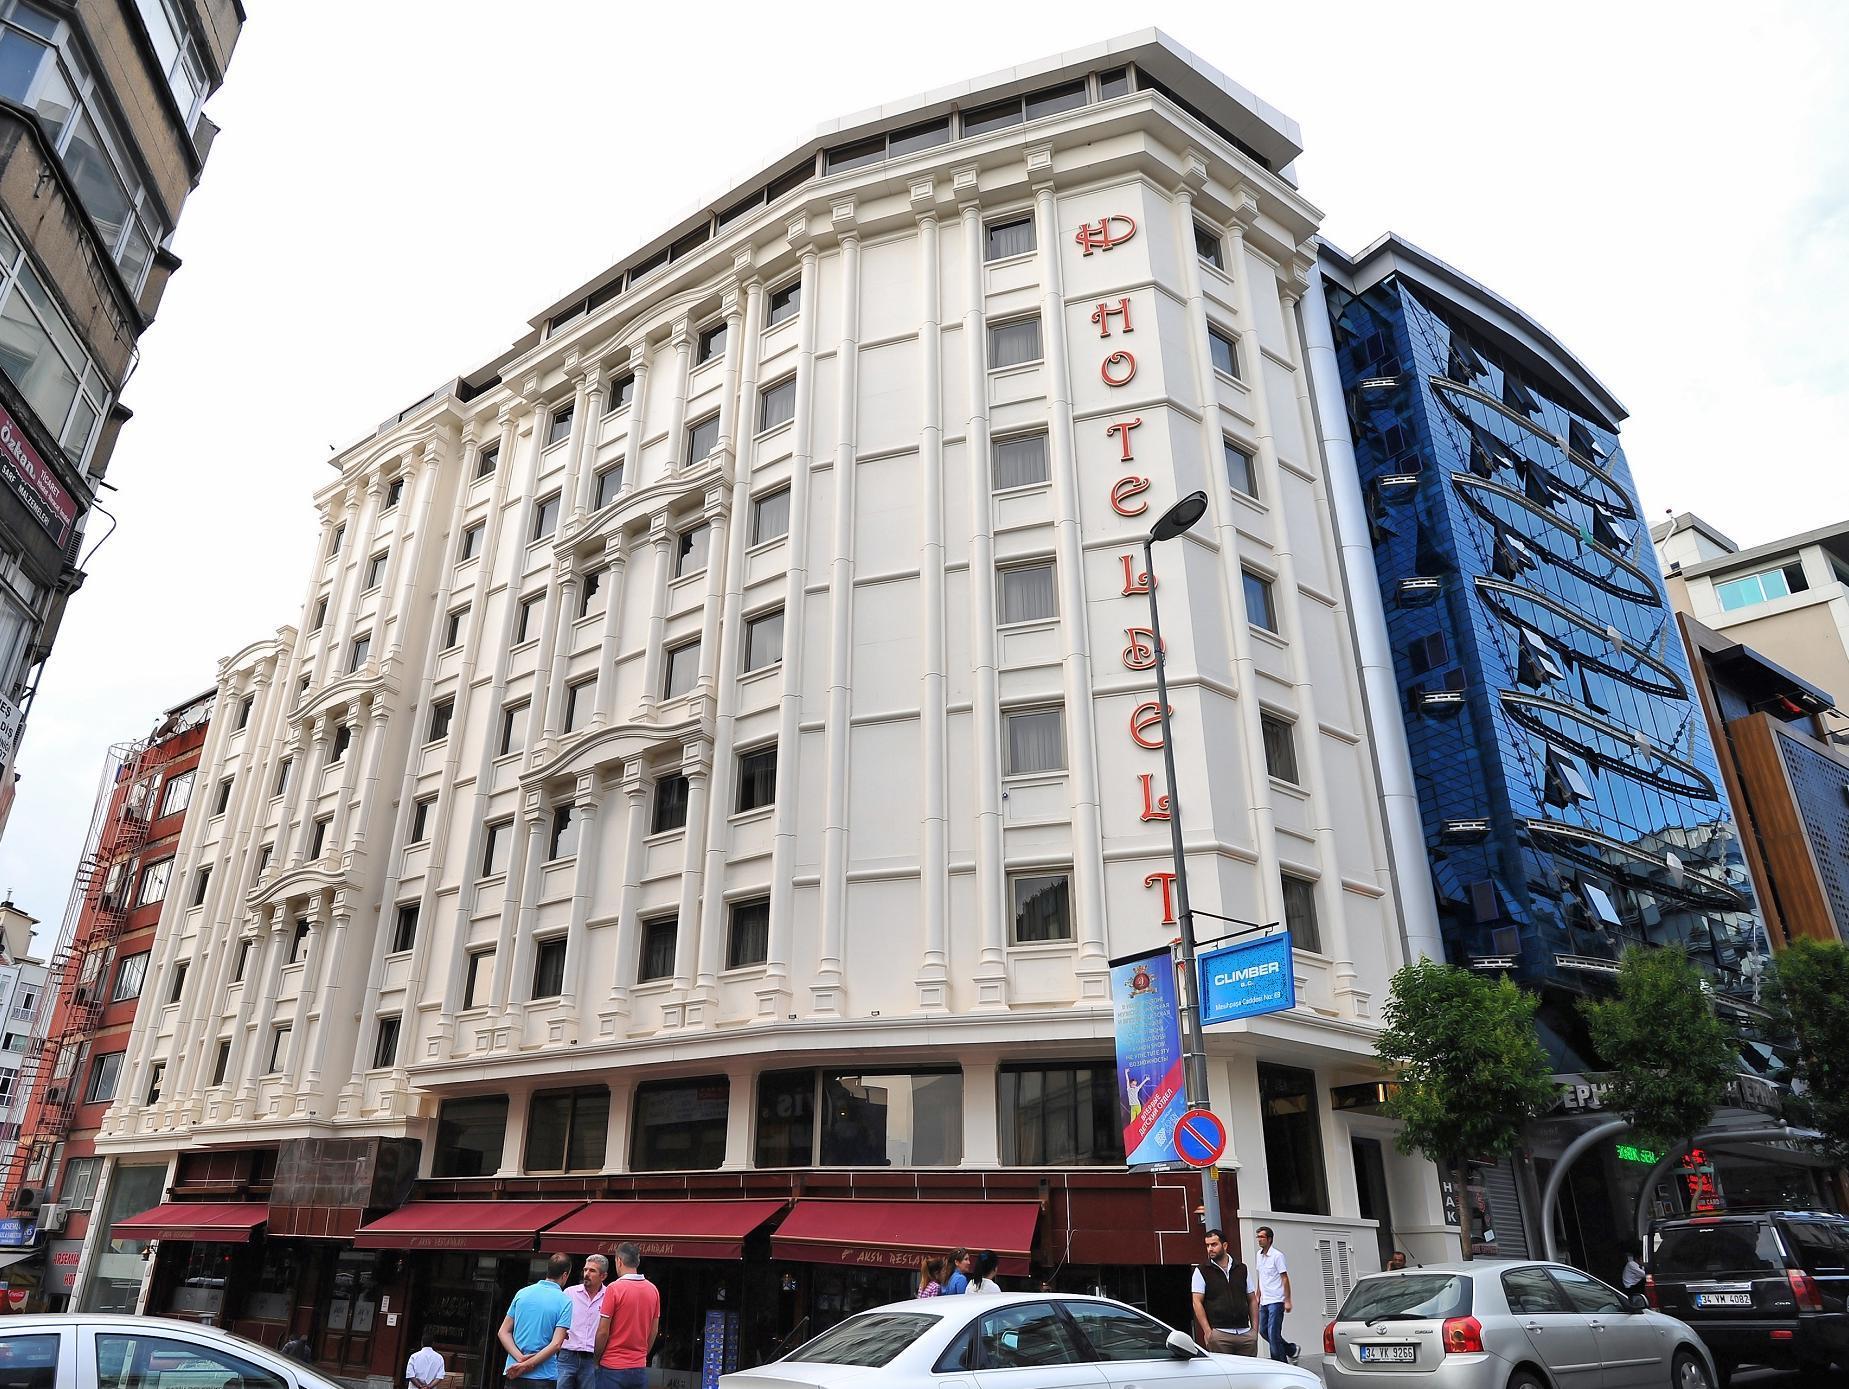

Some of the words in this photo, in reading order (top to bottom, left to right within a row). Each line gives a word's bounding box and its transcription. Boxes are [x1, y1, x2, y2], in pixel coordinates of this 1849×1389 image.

[1, 464, 17, 483] SARF
[1121, 626, 1182, 944] DELT
[1214, 961, 1280, 986] CLIMBER
[1139, 1107, 1159, 1137] ДЕТСКИЙ
[1157, 1087, 1173, 1109] ОТДЕЛ
[1140, 1093, 1161, 1121] ВПЕРВЫЕ
[856, 1249, 883, 1263] AKSU
[1702, 1295, 1711, 1304] 34
[1715, 1295, 1726, 1304] VM
[1730, 1294, 1750, 1304] 4082
[1366, 1347, 1375, 1358] 34
[1380, 1347, 1389, 1358] VK
[1392, 1347, 1413, 1358] 9266
